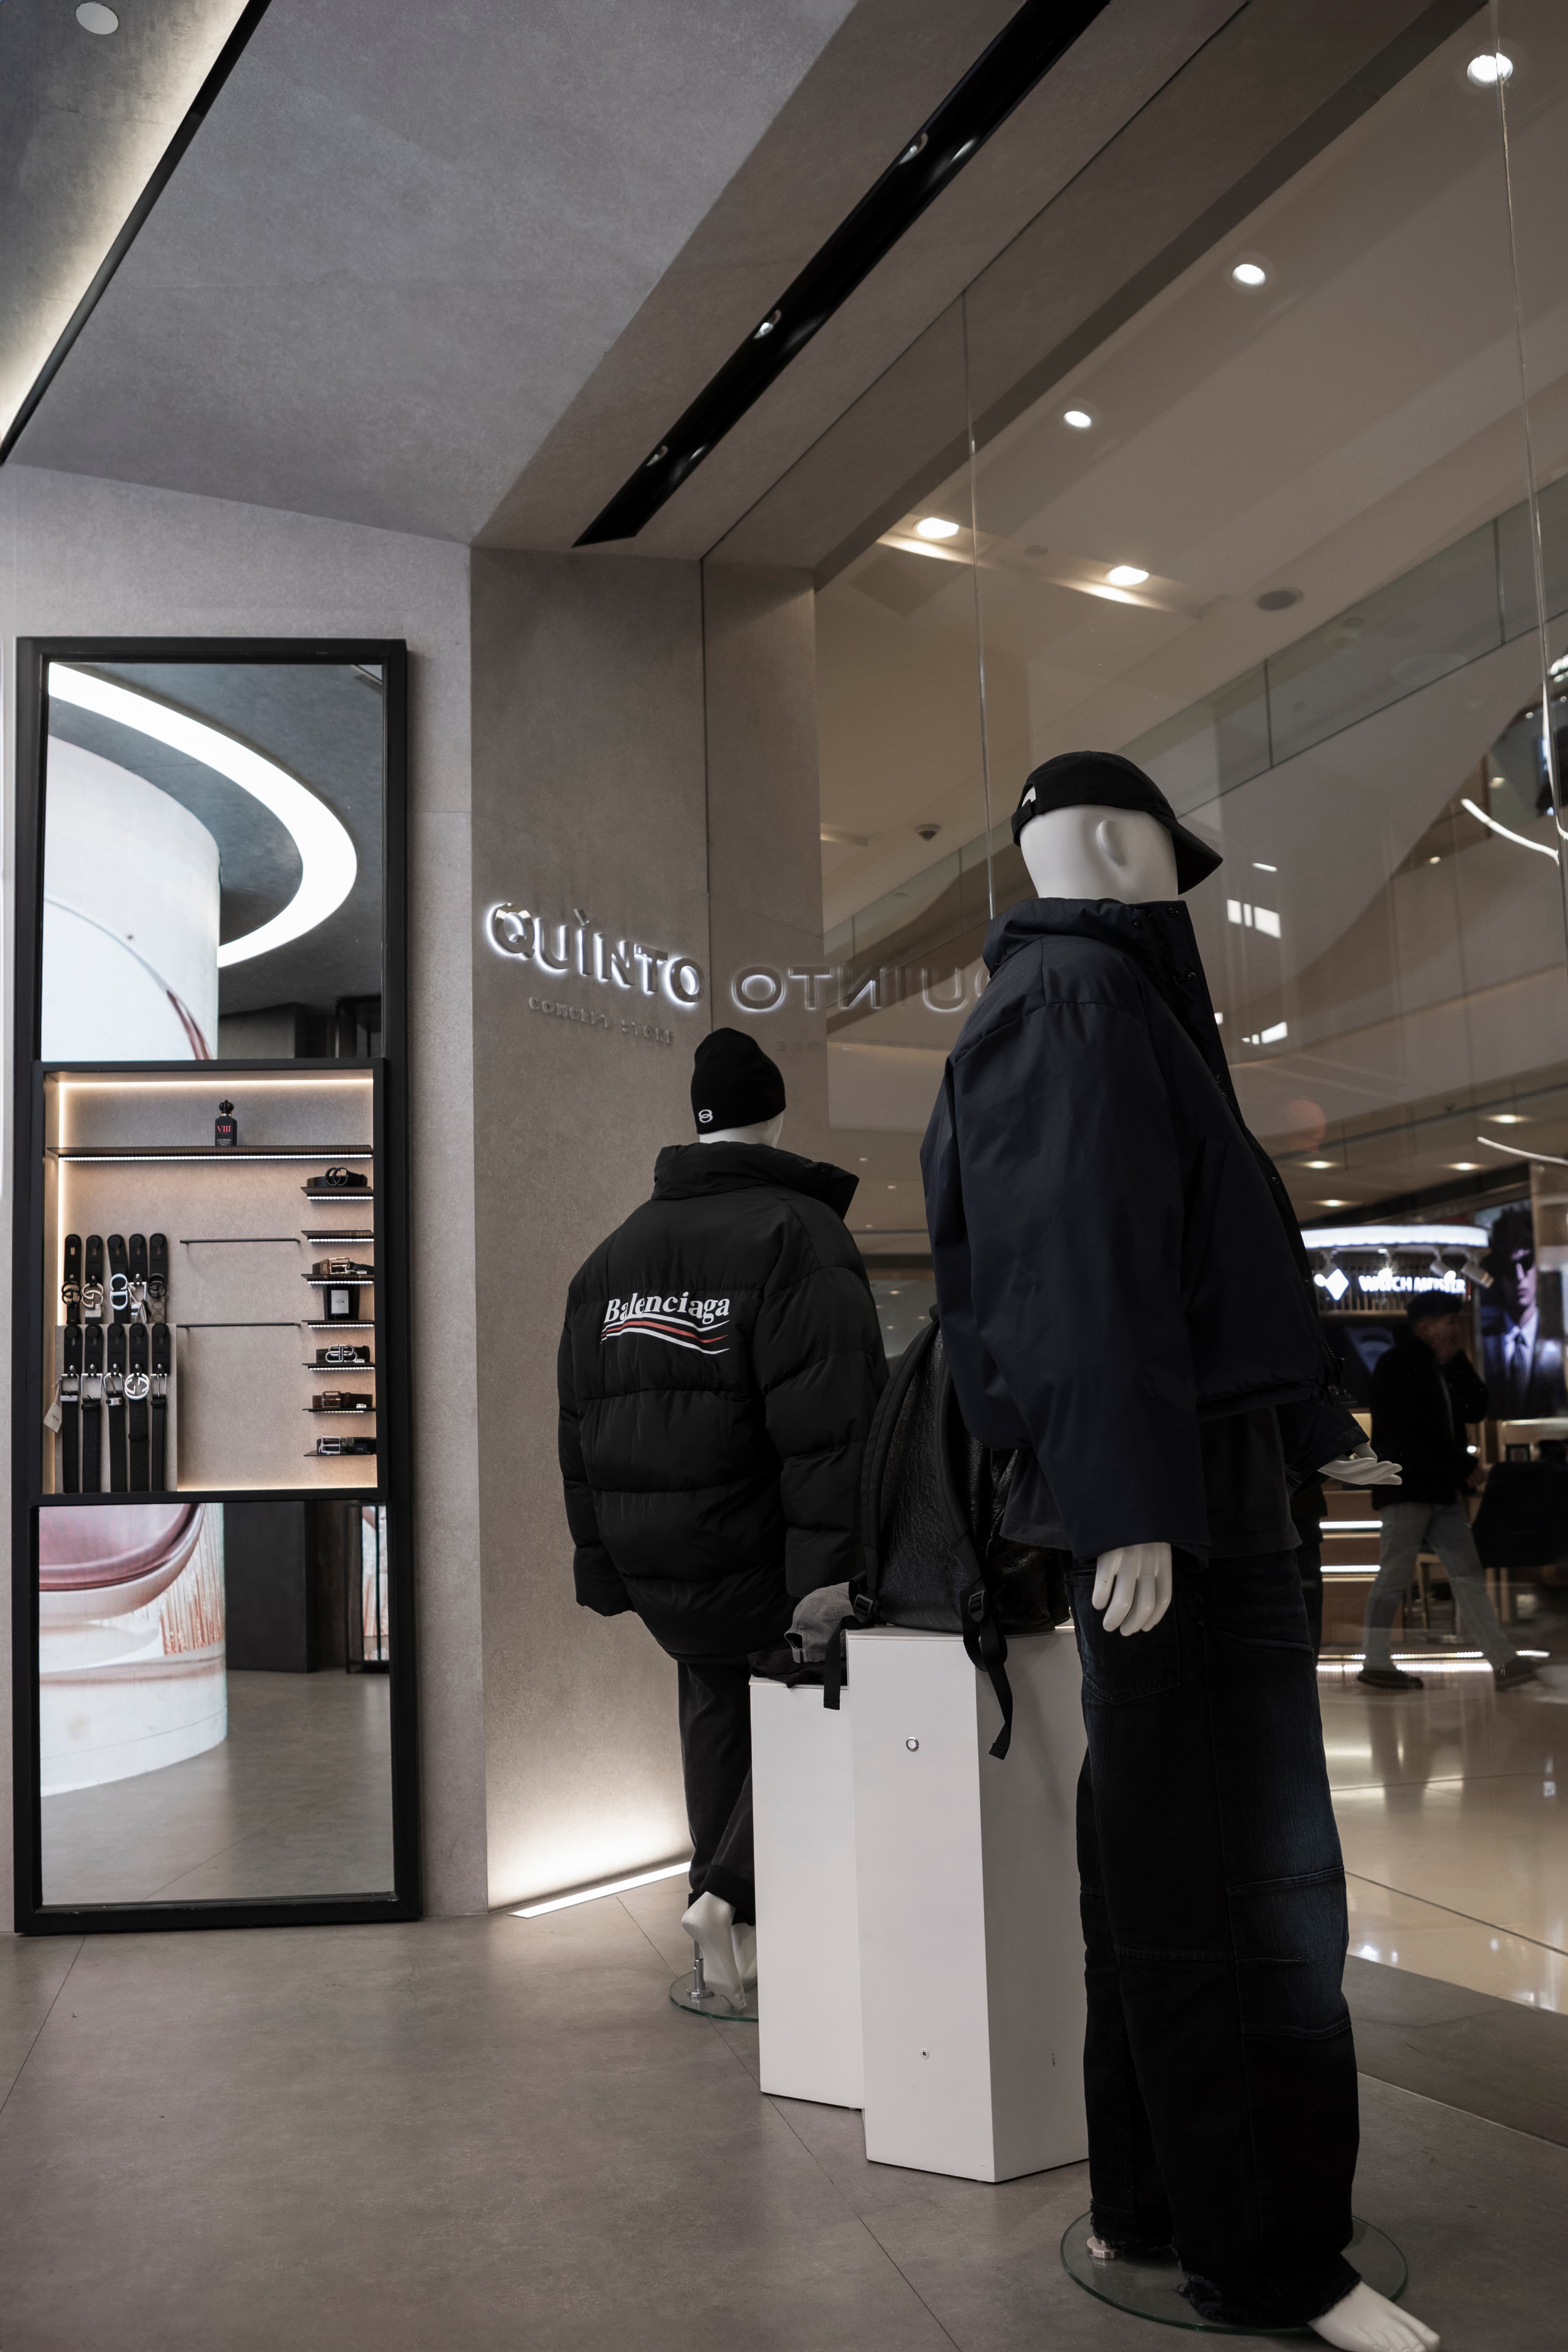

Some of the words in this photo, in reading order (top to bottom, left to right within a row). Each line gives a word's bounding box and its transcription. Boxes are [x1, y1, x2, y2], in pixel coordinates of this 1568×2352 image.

[528, 996, 611, 1028] CONCEPT
[621, 1019, 674, 1044] STORE
[1358, 1275, 1412, 1292] WCH
[604, 1292, 730, 1324] Balenciaga
